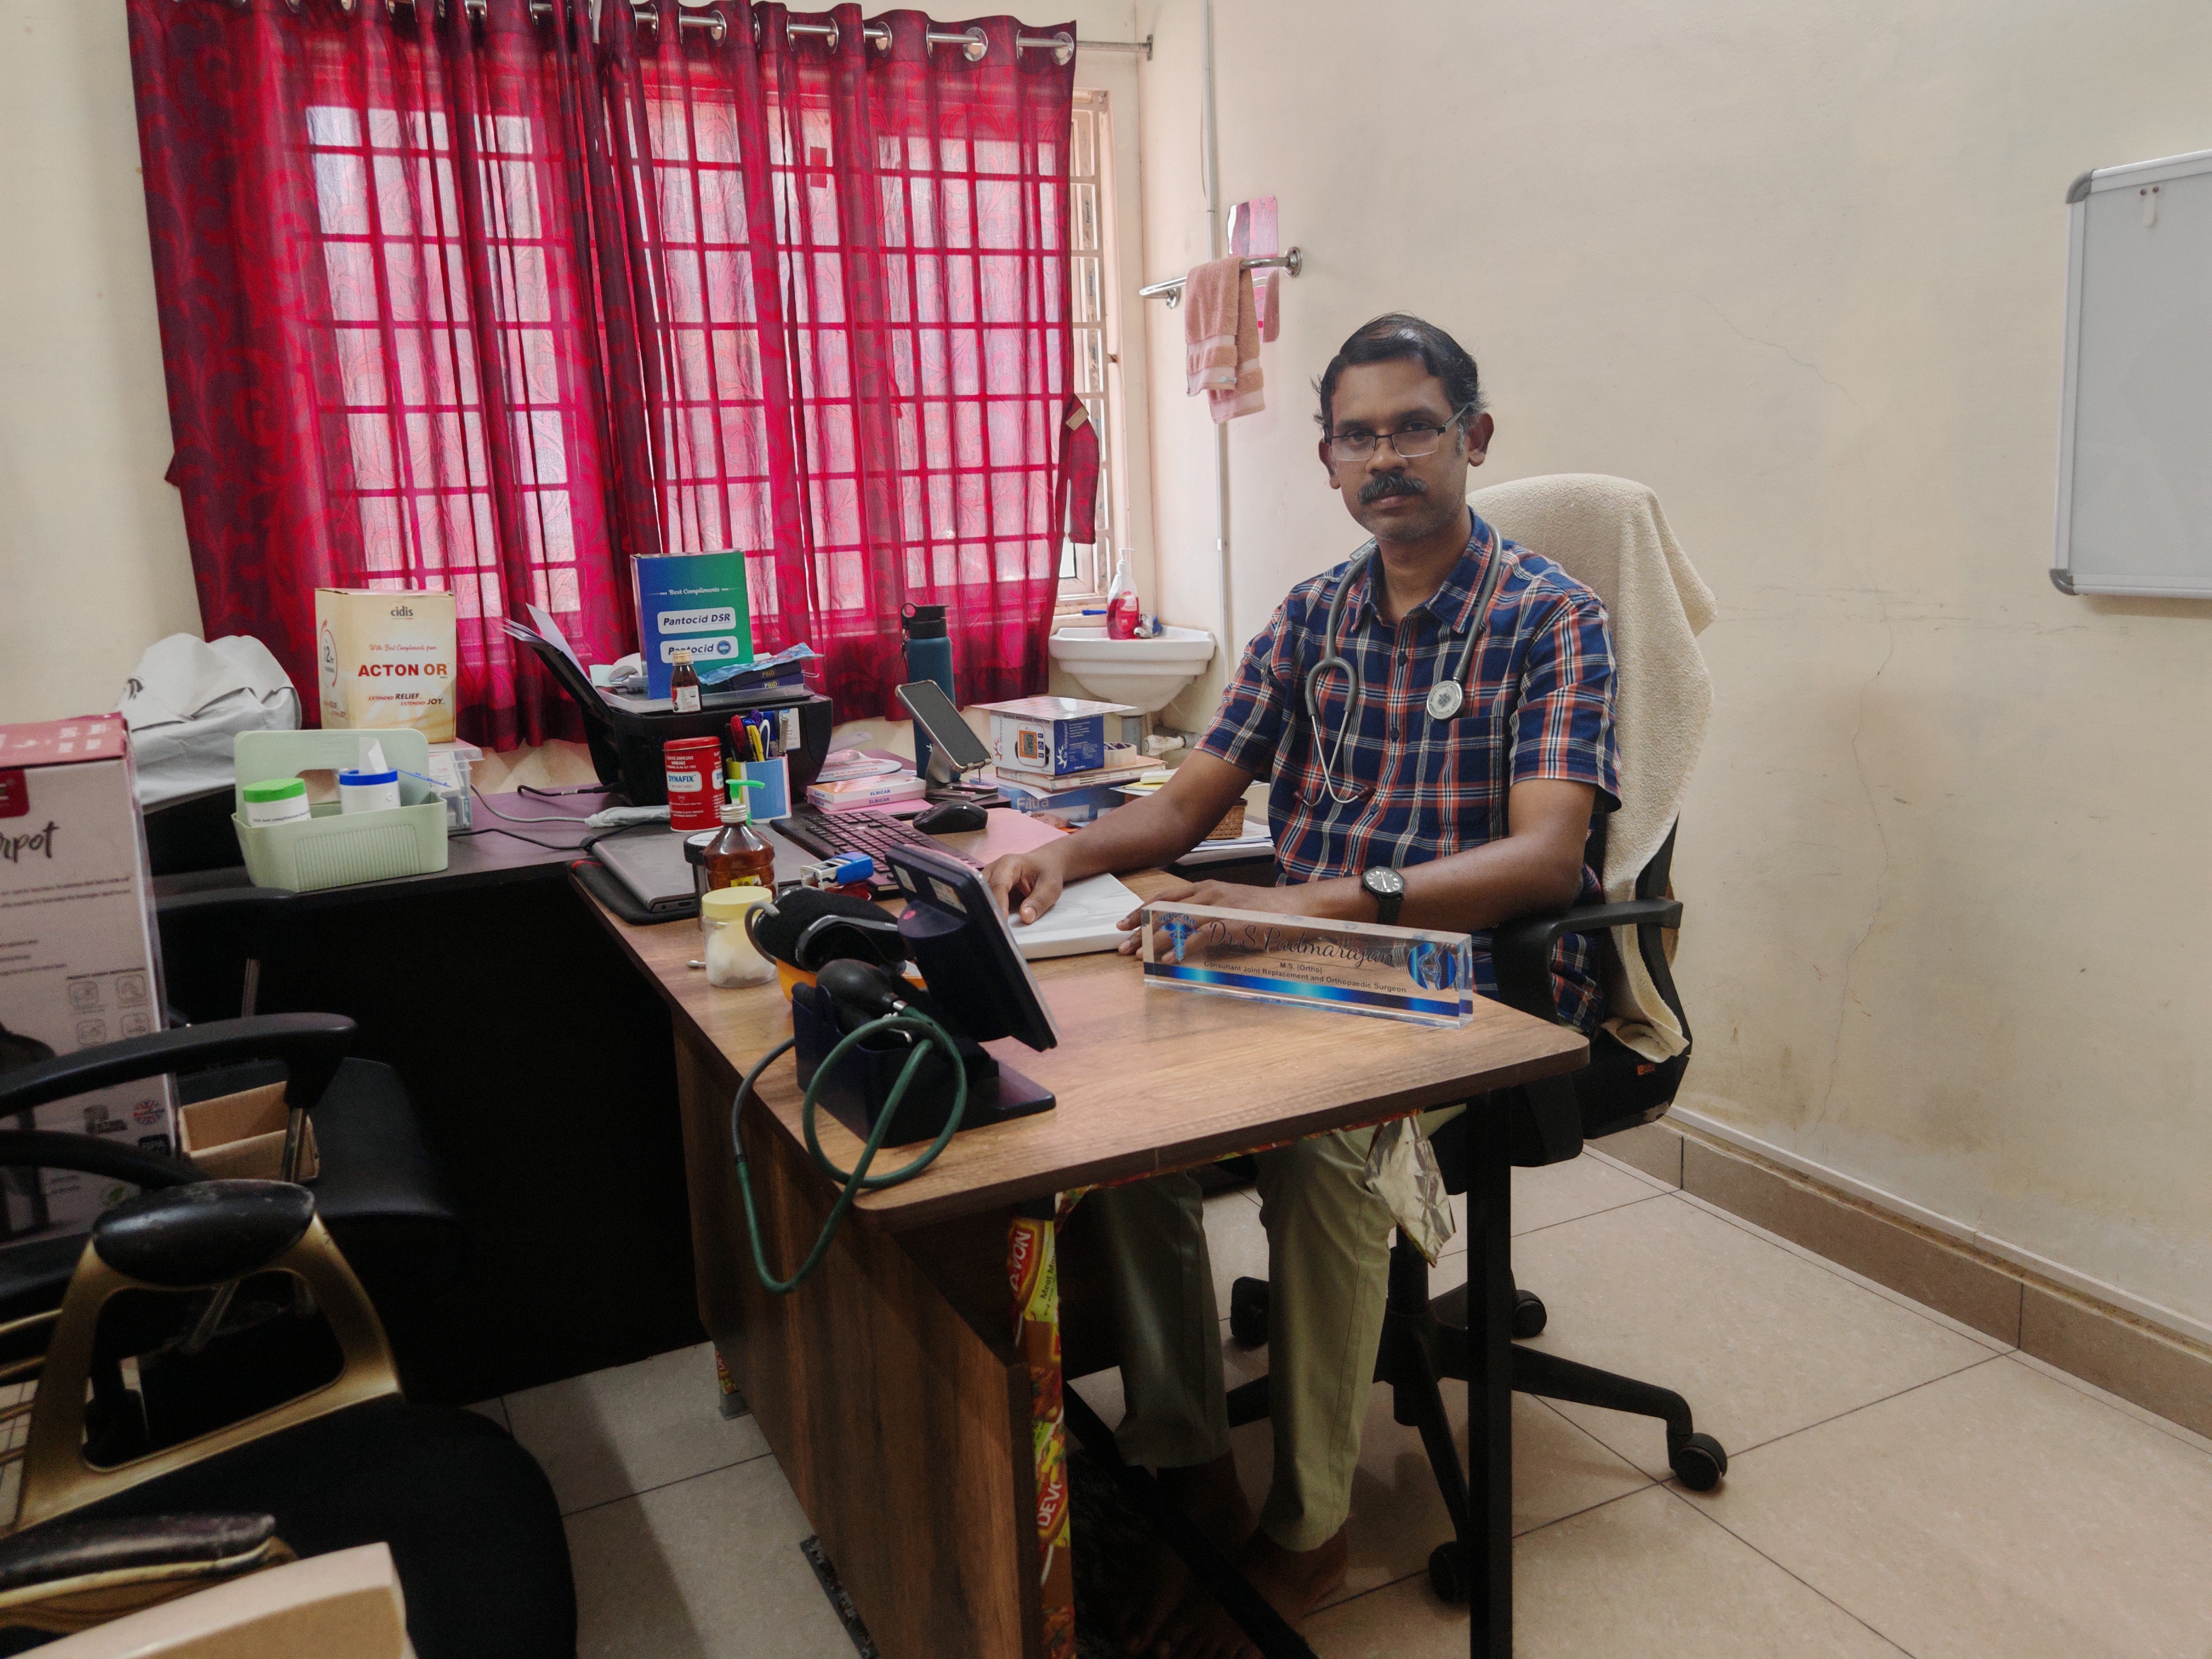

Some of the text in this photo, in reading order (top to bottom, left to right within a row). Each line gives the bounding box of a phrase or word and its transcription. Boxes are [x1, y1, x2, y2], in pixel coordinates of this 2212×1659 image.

[683, 587, 720, 596] Compliments
[390, 605, 414, 617] cidis
[663, 613, 731, 626] Pantocid DSR
[358, 663, 448, 677] ACTON OR
[1016, 795, 1049, 810] Filtra
[1297, 965, 1323, 974] (Ortho)
[1204, 961, 1241, 971] Consultant
[1262, 968, 1309, 980] Replacement
[1326, 976, 1372, 989] Orthopaedic
[1374, 983, 1407, 993] Surgeon
